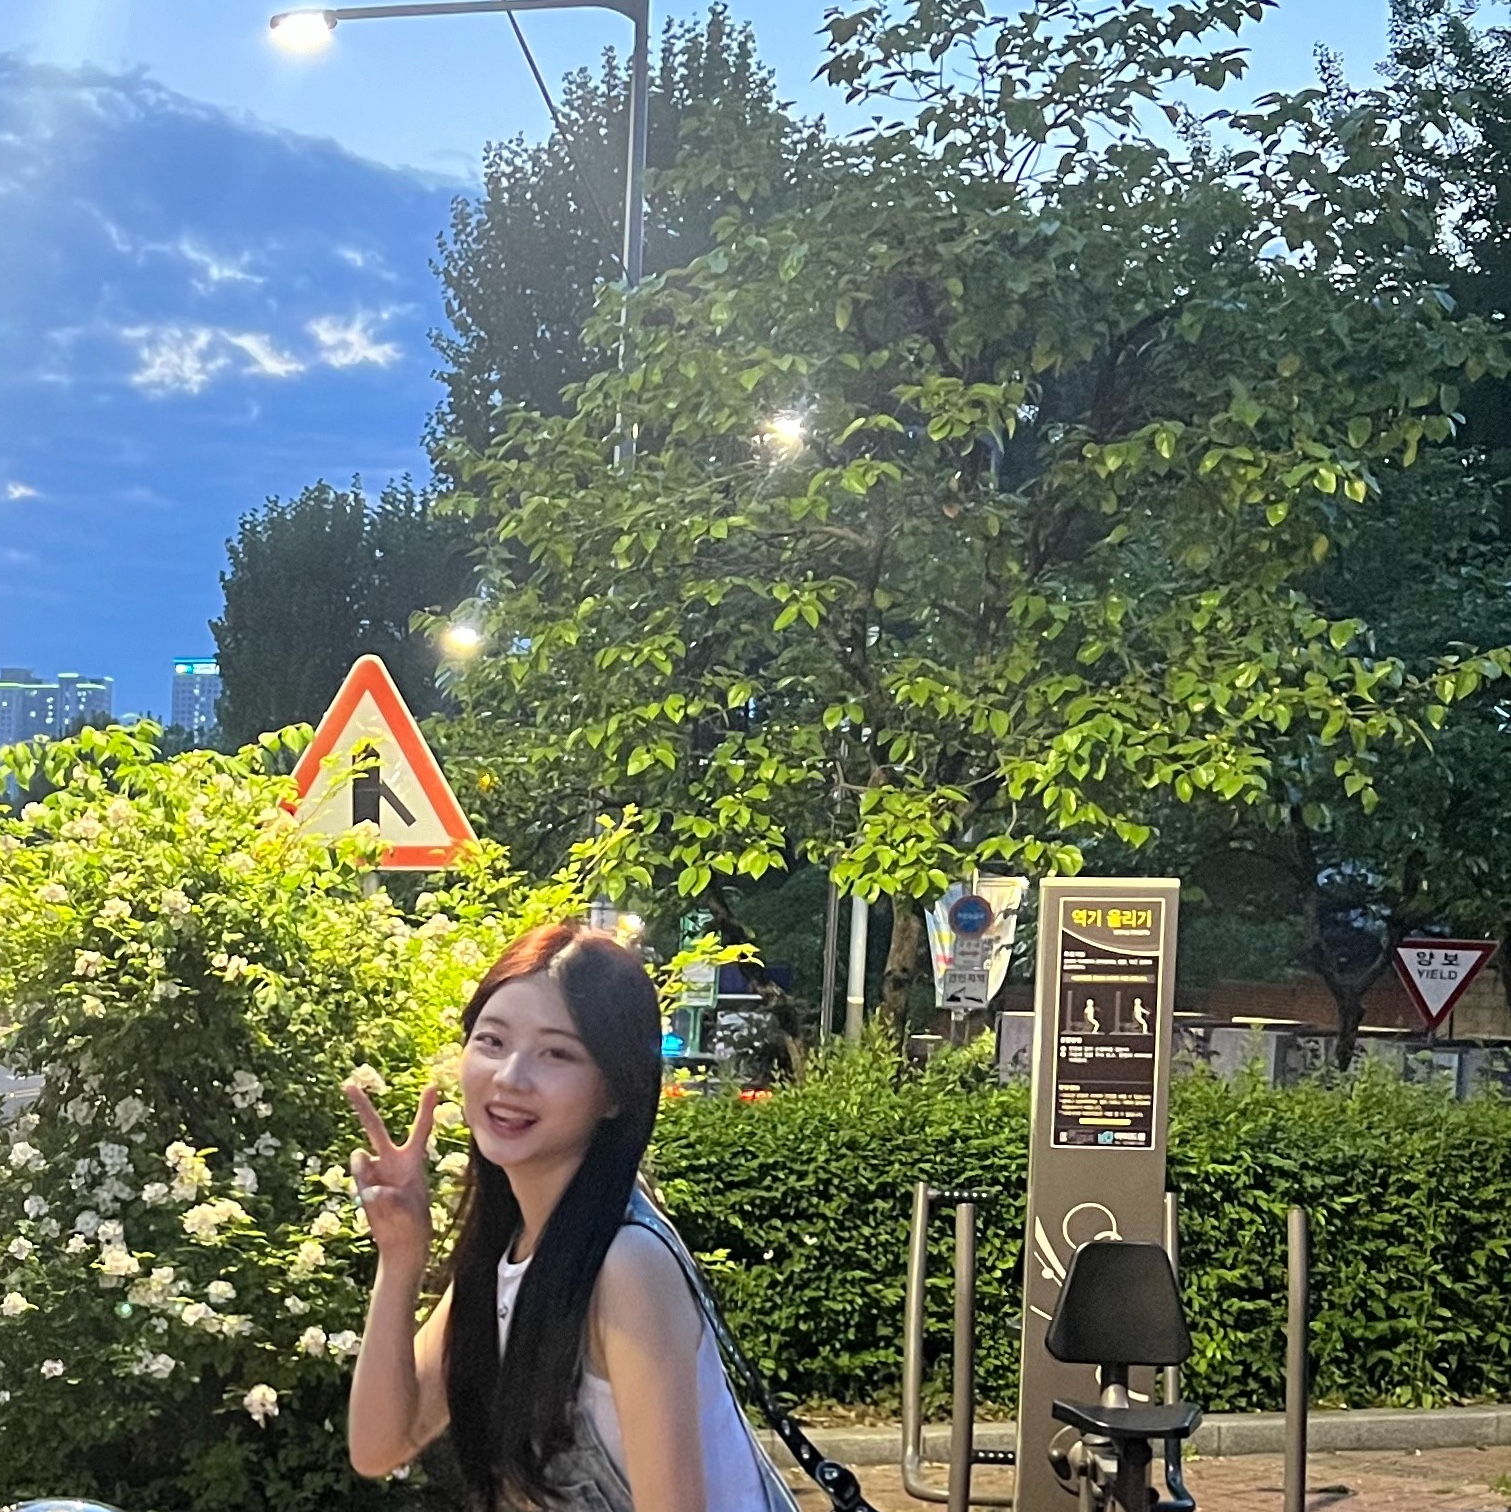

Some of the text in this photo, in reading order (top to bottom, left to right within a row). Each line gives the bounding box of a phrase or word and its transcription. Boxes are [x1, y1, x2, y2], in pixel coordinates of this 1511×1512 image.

[1071, 908, 1152, 928] 역기 올리기
[1417, 968, 1458, 980] YIELD
